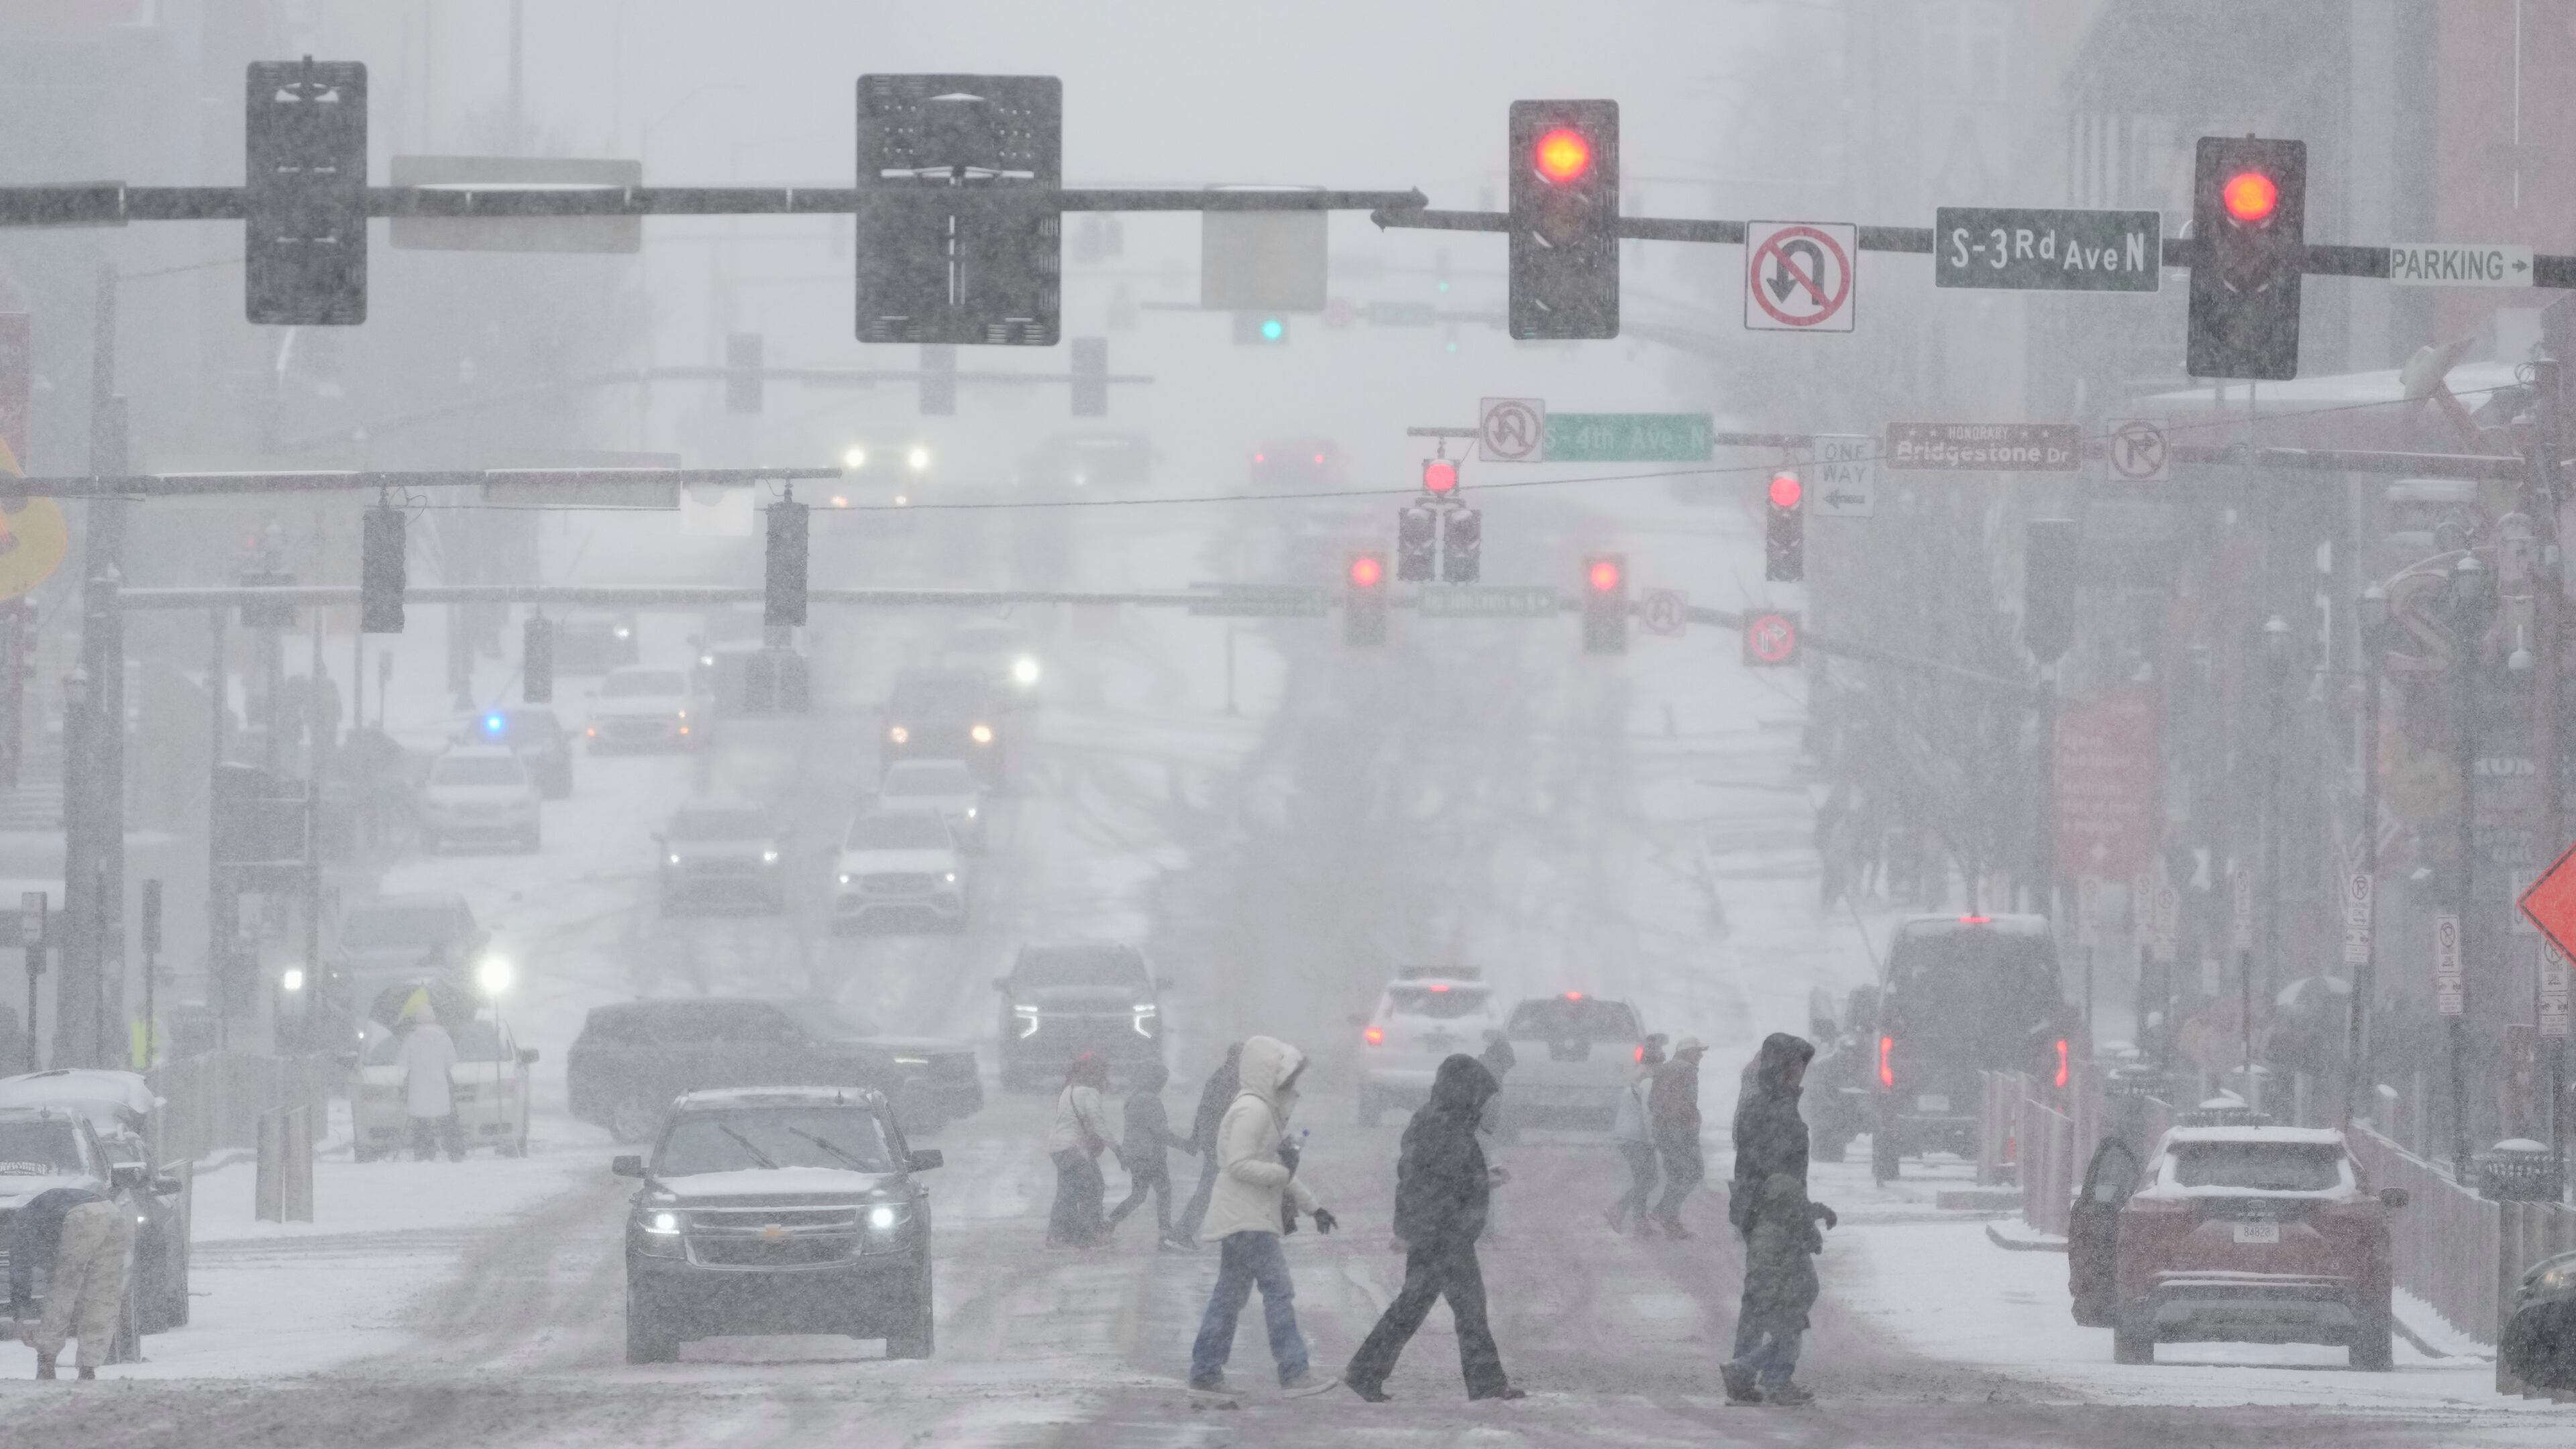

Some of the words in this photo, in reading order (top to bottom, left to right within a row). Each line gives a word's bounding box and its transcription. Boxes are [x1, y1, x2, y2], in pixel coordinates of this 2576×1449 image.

[2063, 240, 2118, 270] Ave
[2126, 232, 2145, 272] N
[2391, 248, 2504, 280] PARKING
[1948, 426, 2009, 441] HONORARY
[1825, 443, 1866, 461] ONE
[1897, 441, 2041, 466] Bridgestone
[2047, 447, 2069, 464] Dr
[1823, 465, 1866, 483] WAY
